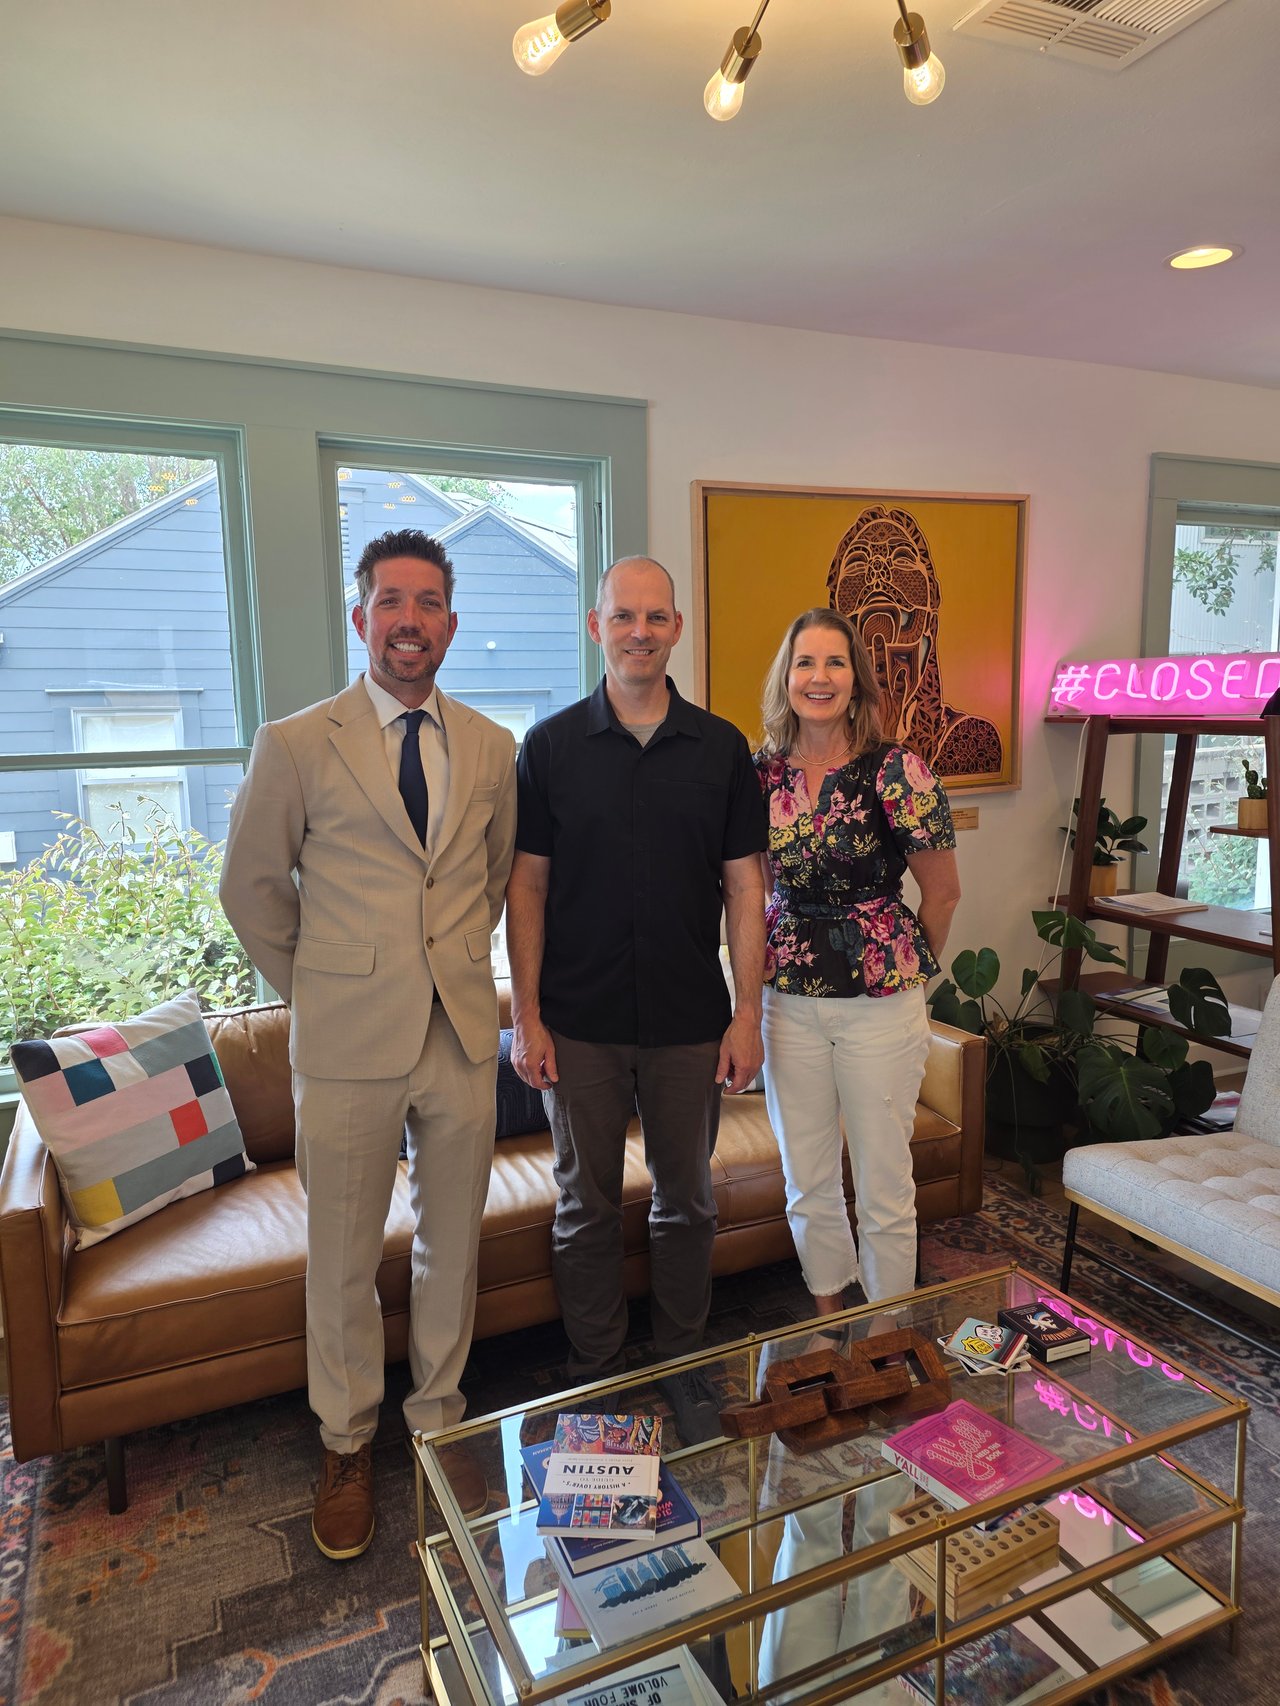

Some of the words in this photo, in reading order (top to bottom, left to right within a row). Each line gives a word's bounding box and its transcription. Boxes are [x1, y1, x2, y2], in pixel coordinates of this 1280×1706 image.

[1051, 659, 1280, 702] #CLOSED
[563, 1464, 634, 1475] AUSTIN
[894, 1453, 919, 1481] Y'ALL
[565, 1481, 592, 1490] LOVER'S
[623, 1675, 668, 1699] VOLUME
[648, 1691, 662, 1706] OF
